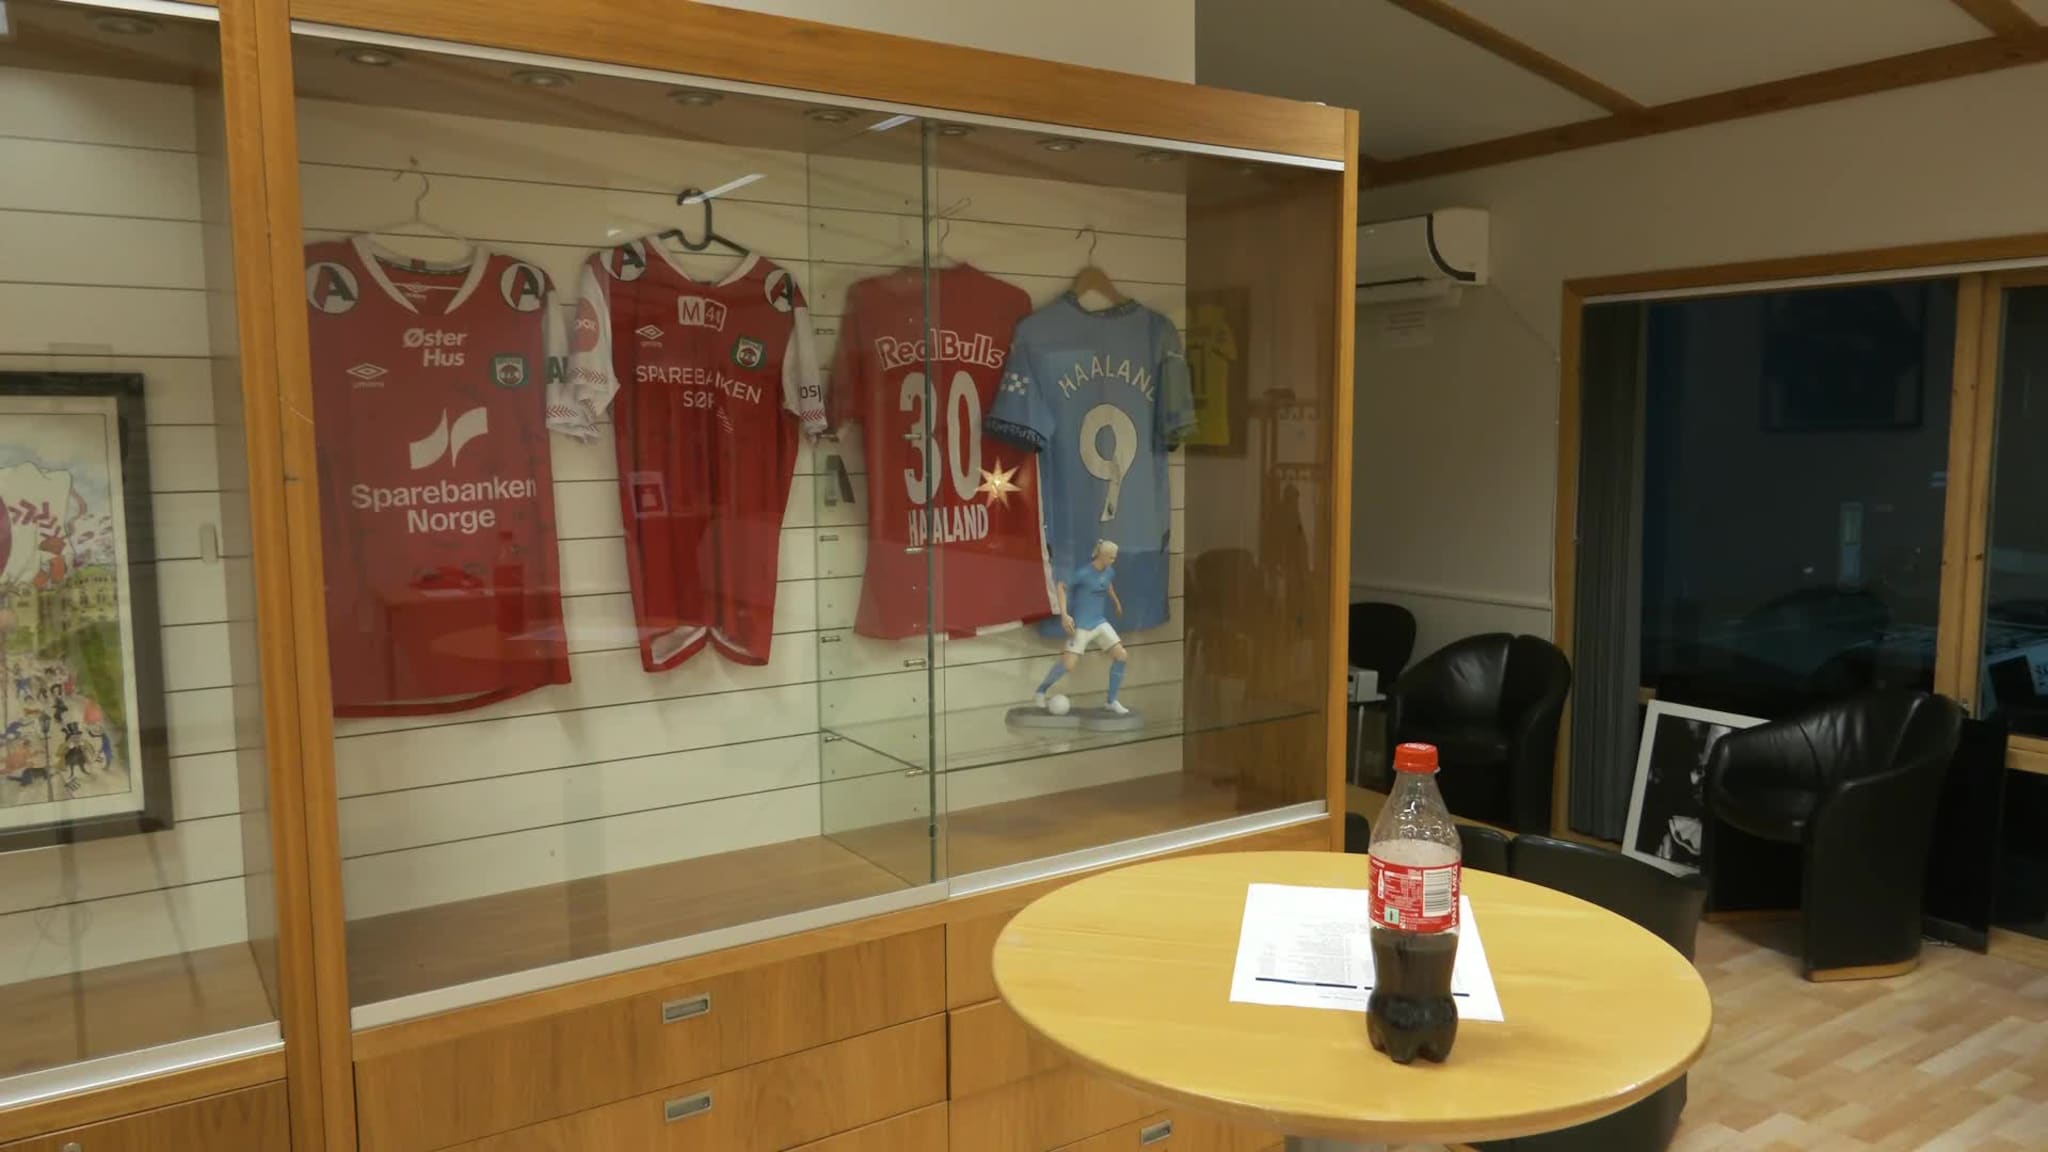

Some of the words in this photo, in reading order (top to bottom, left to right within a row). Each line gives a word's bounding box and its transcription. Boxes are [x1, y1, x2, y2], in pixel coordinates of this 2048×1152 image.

[402, 328, 466, 348] Øster
[875, 328, 938, 371] Red
[939, 330, 1005, 368] Bulls
[423, 348, 465, 367] Hus
[636, 365, 762, 404] SPAREBKEN
[900, 370, 983, 505] 30
[1079, 404, 1138, 522] 9
[350, 476, 537, 512] Sparebanken
[407, 508, 496, 534] Norge
